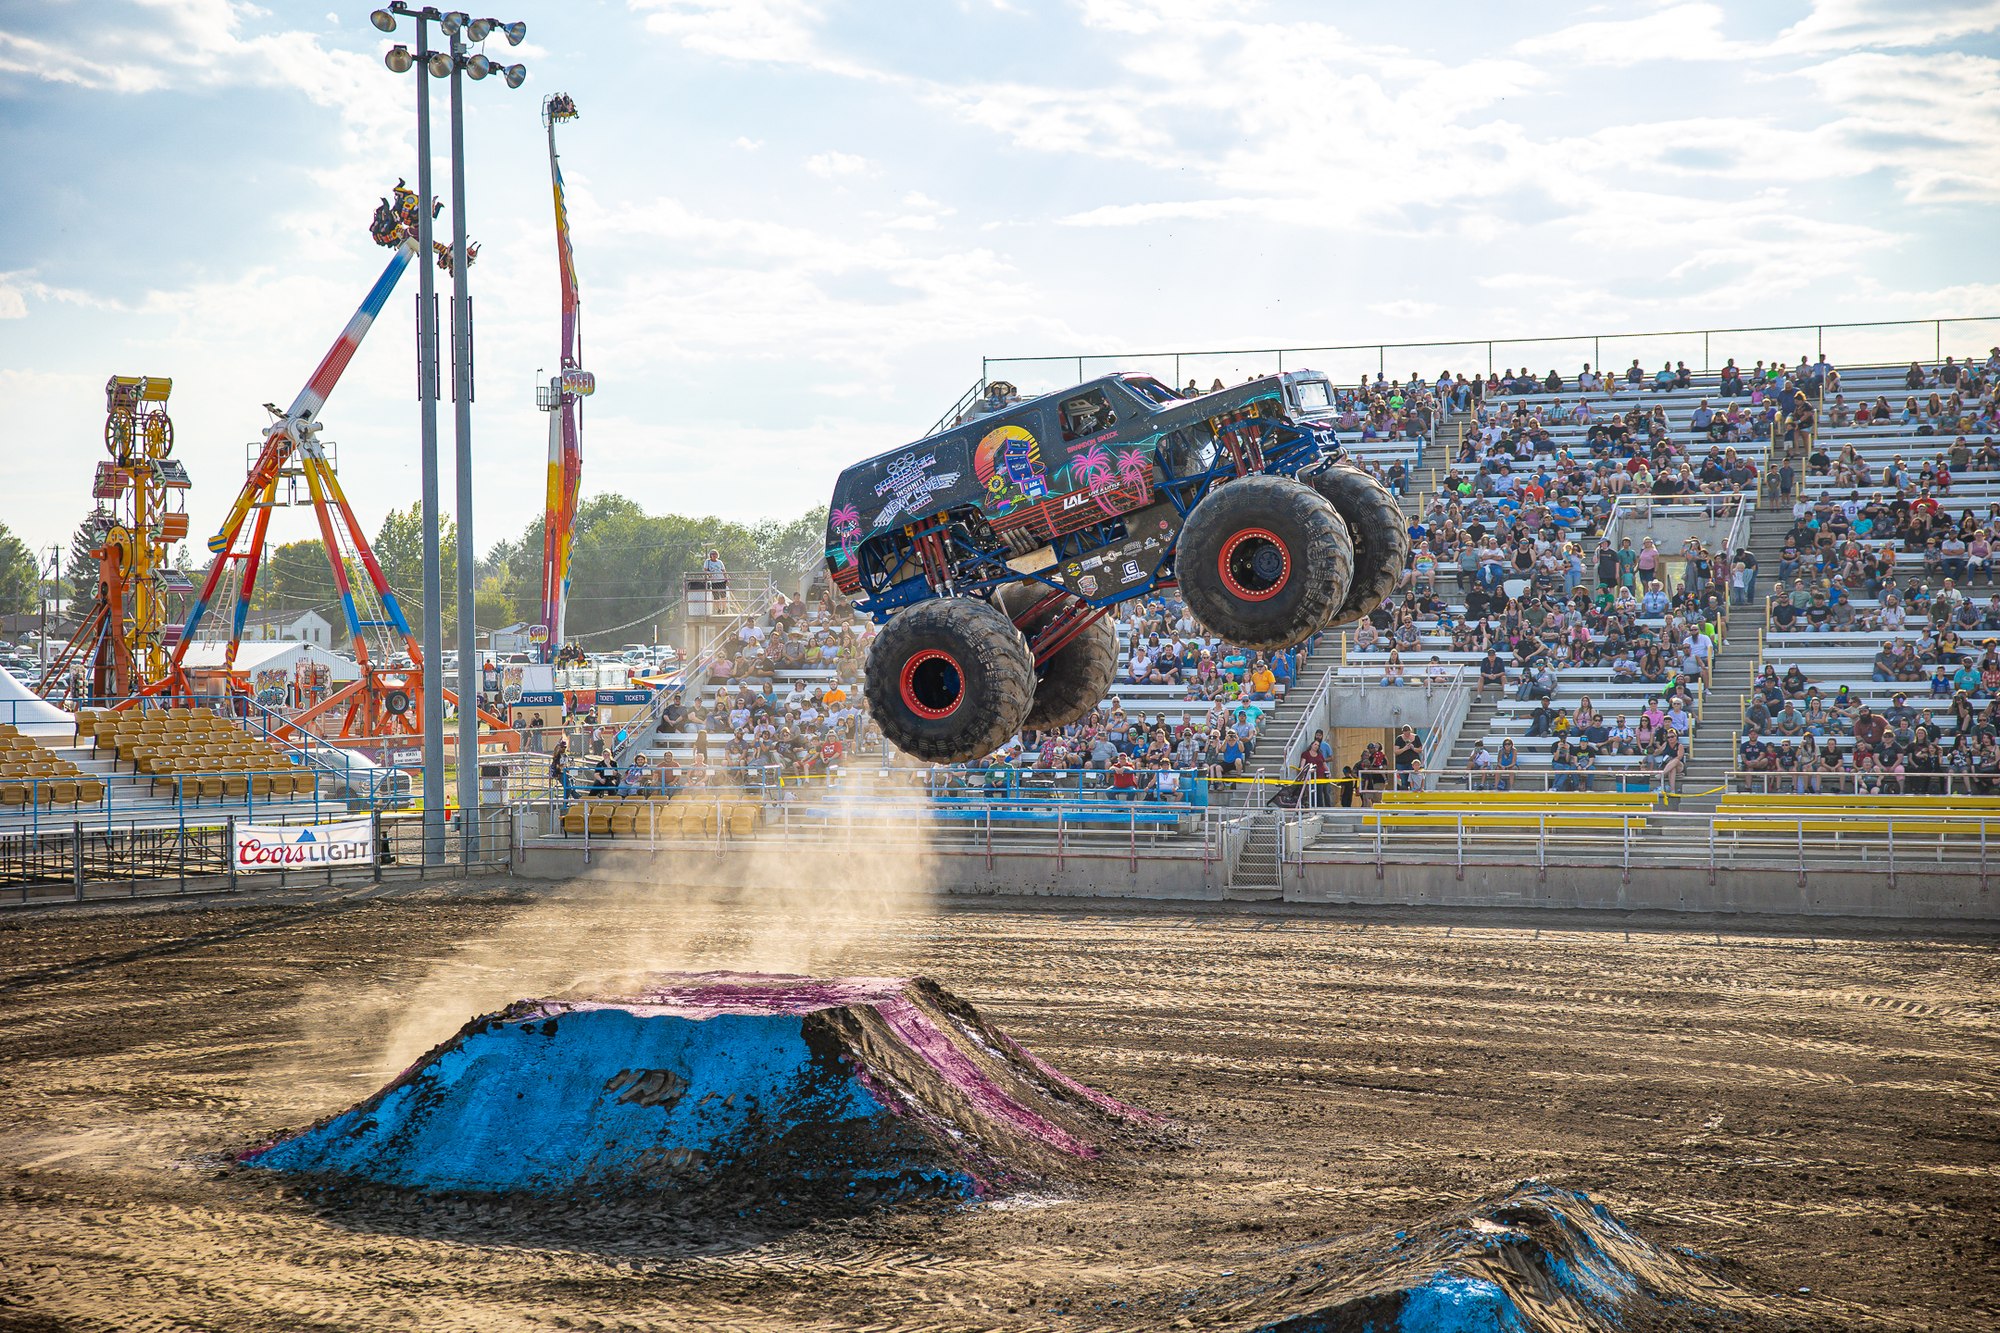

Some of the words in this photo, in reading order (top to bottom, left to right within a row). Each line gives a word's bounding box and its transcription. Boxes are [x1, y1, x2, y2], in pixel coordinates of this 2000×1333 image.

[874, 453, 937, 497] MONSTER
[896, 476, 926, 497] INSANITY
[523, 695, 553, 703] TICKETS
[239, 839, 306, 864] Coors
[309, 842, 368, 862] LIGHT
